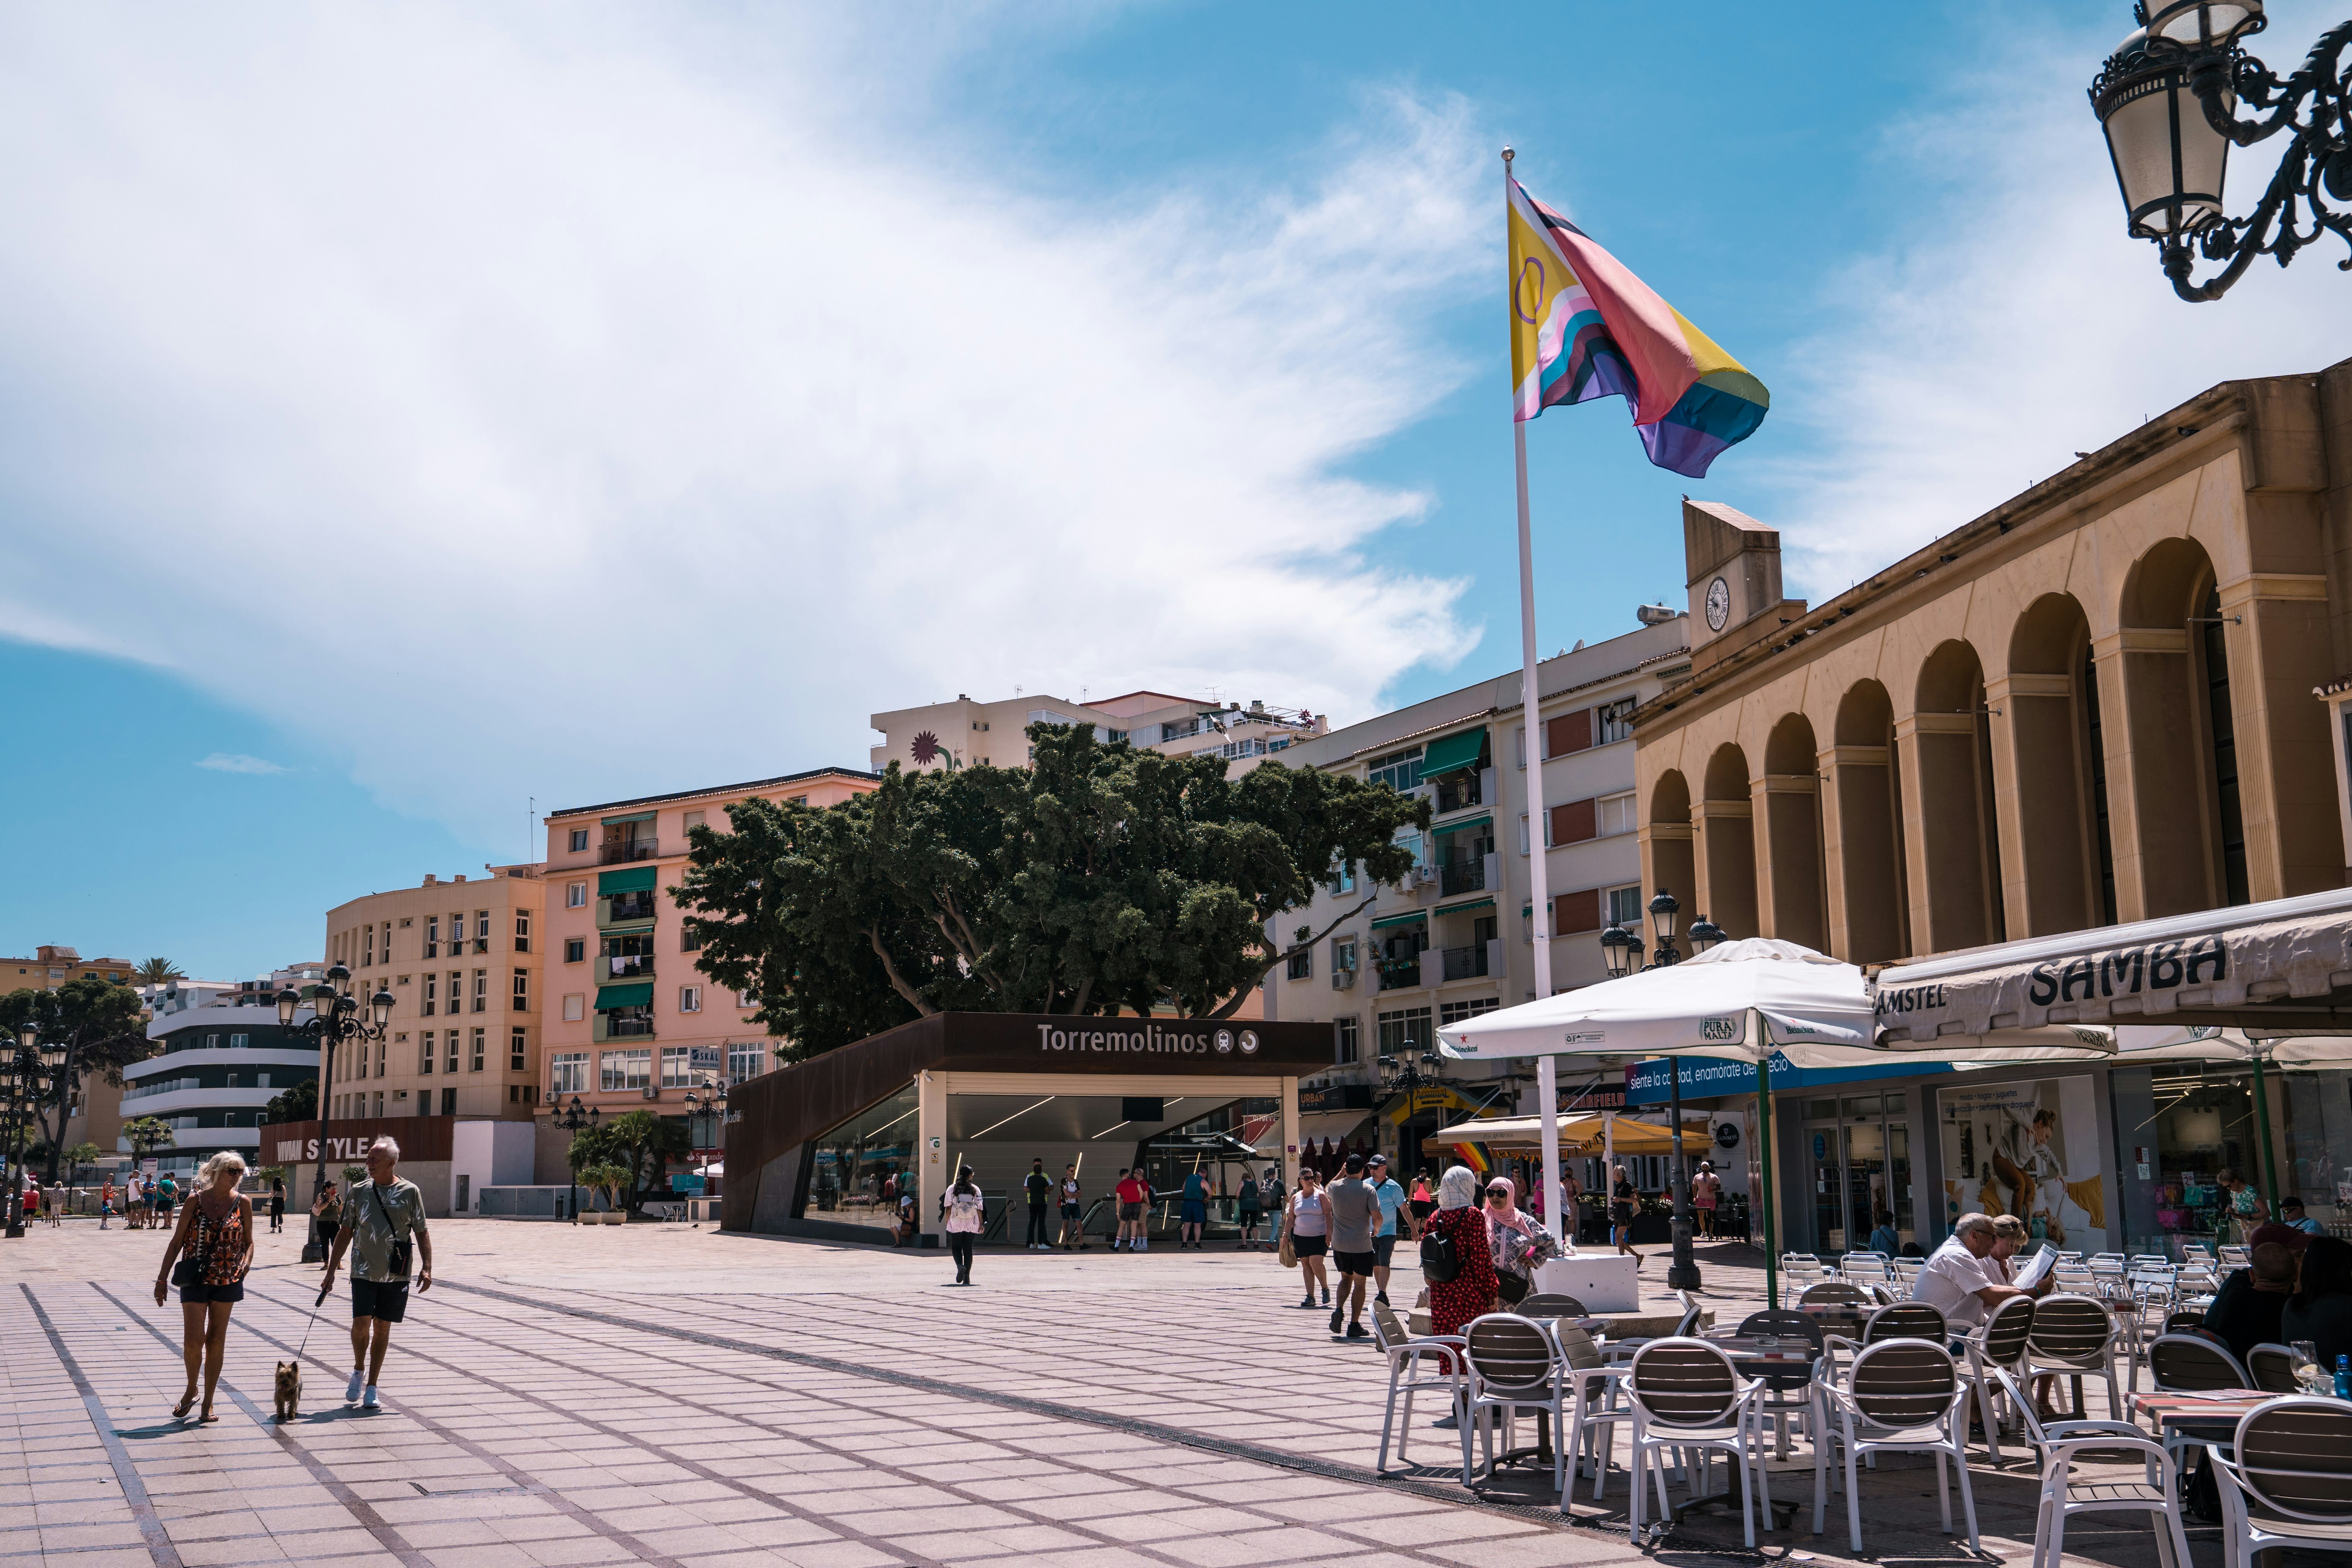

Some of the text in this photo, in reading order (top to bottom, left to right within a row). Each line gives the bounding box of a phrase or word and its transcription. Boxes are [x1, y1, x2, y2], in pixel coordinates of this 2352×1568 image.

[2030, 932, 2226, 1006] SAMBA
[1875, 983, 1946, 1015] AMSTEL
[1703, 1021, 1733, 1032] PURA
[1037, 1024, 1207, 1053] Torremolinos
[1703, 1031, 1732, 1040] MALTA
[2075, 1030, 2103, 1040] PURA
[2081, 1036, 2105, 1047] MALTA
[700, 1050, 718, 1061] SKÅL
[1630, 1074, 1652, 1090] siente
[1654, 1071, 1660, 1086] la
[1695, 1063, 1740, 1081] enamórate
[1301, 1093, 1325, 1103] URBAN
[1415, 1088, 1449, 1100] ADMIRAL
[1977, 1092, 1992, 1101] hogar
[1996, 1090, 2018, 1100] juguetes
[1945, 1104, 1975, 1113] alimentación
[729, 1110, 741, 1123] adif
[278, 1140, 302, 1162] VIVIAN
